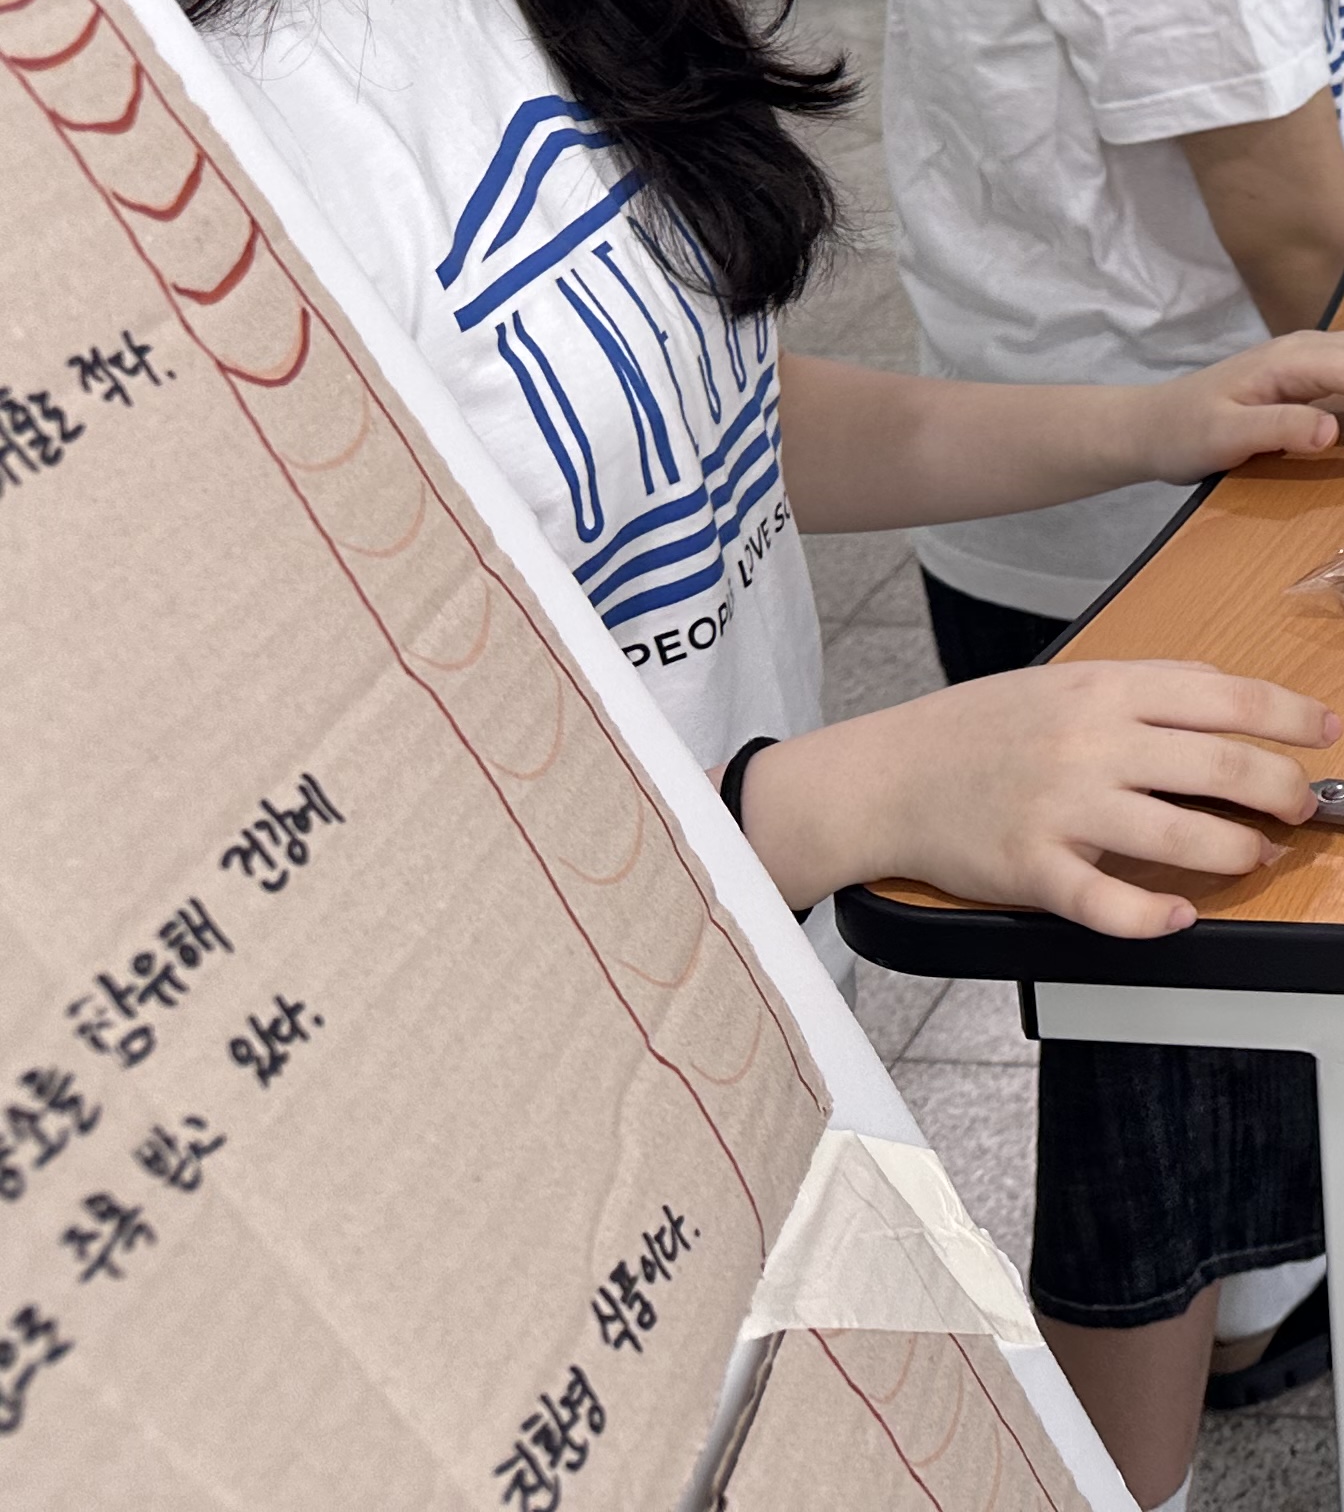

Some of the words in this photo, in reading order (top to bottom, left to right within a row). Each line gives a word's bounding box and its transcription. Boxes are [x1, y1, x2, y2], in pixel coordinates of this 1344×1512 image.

[66, 328, 178, 408] 적다.
[64, 895, 235, 1068] 함유해
[219, 772, 346, 894] 건강에
[227, 993, 325, 1088] 있다.
[492, 1363, 609, 1512] 친환경
[589, 1203, 703, 1355] 식품이다.
